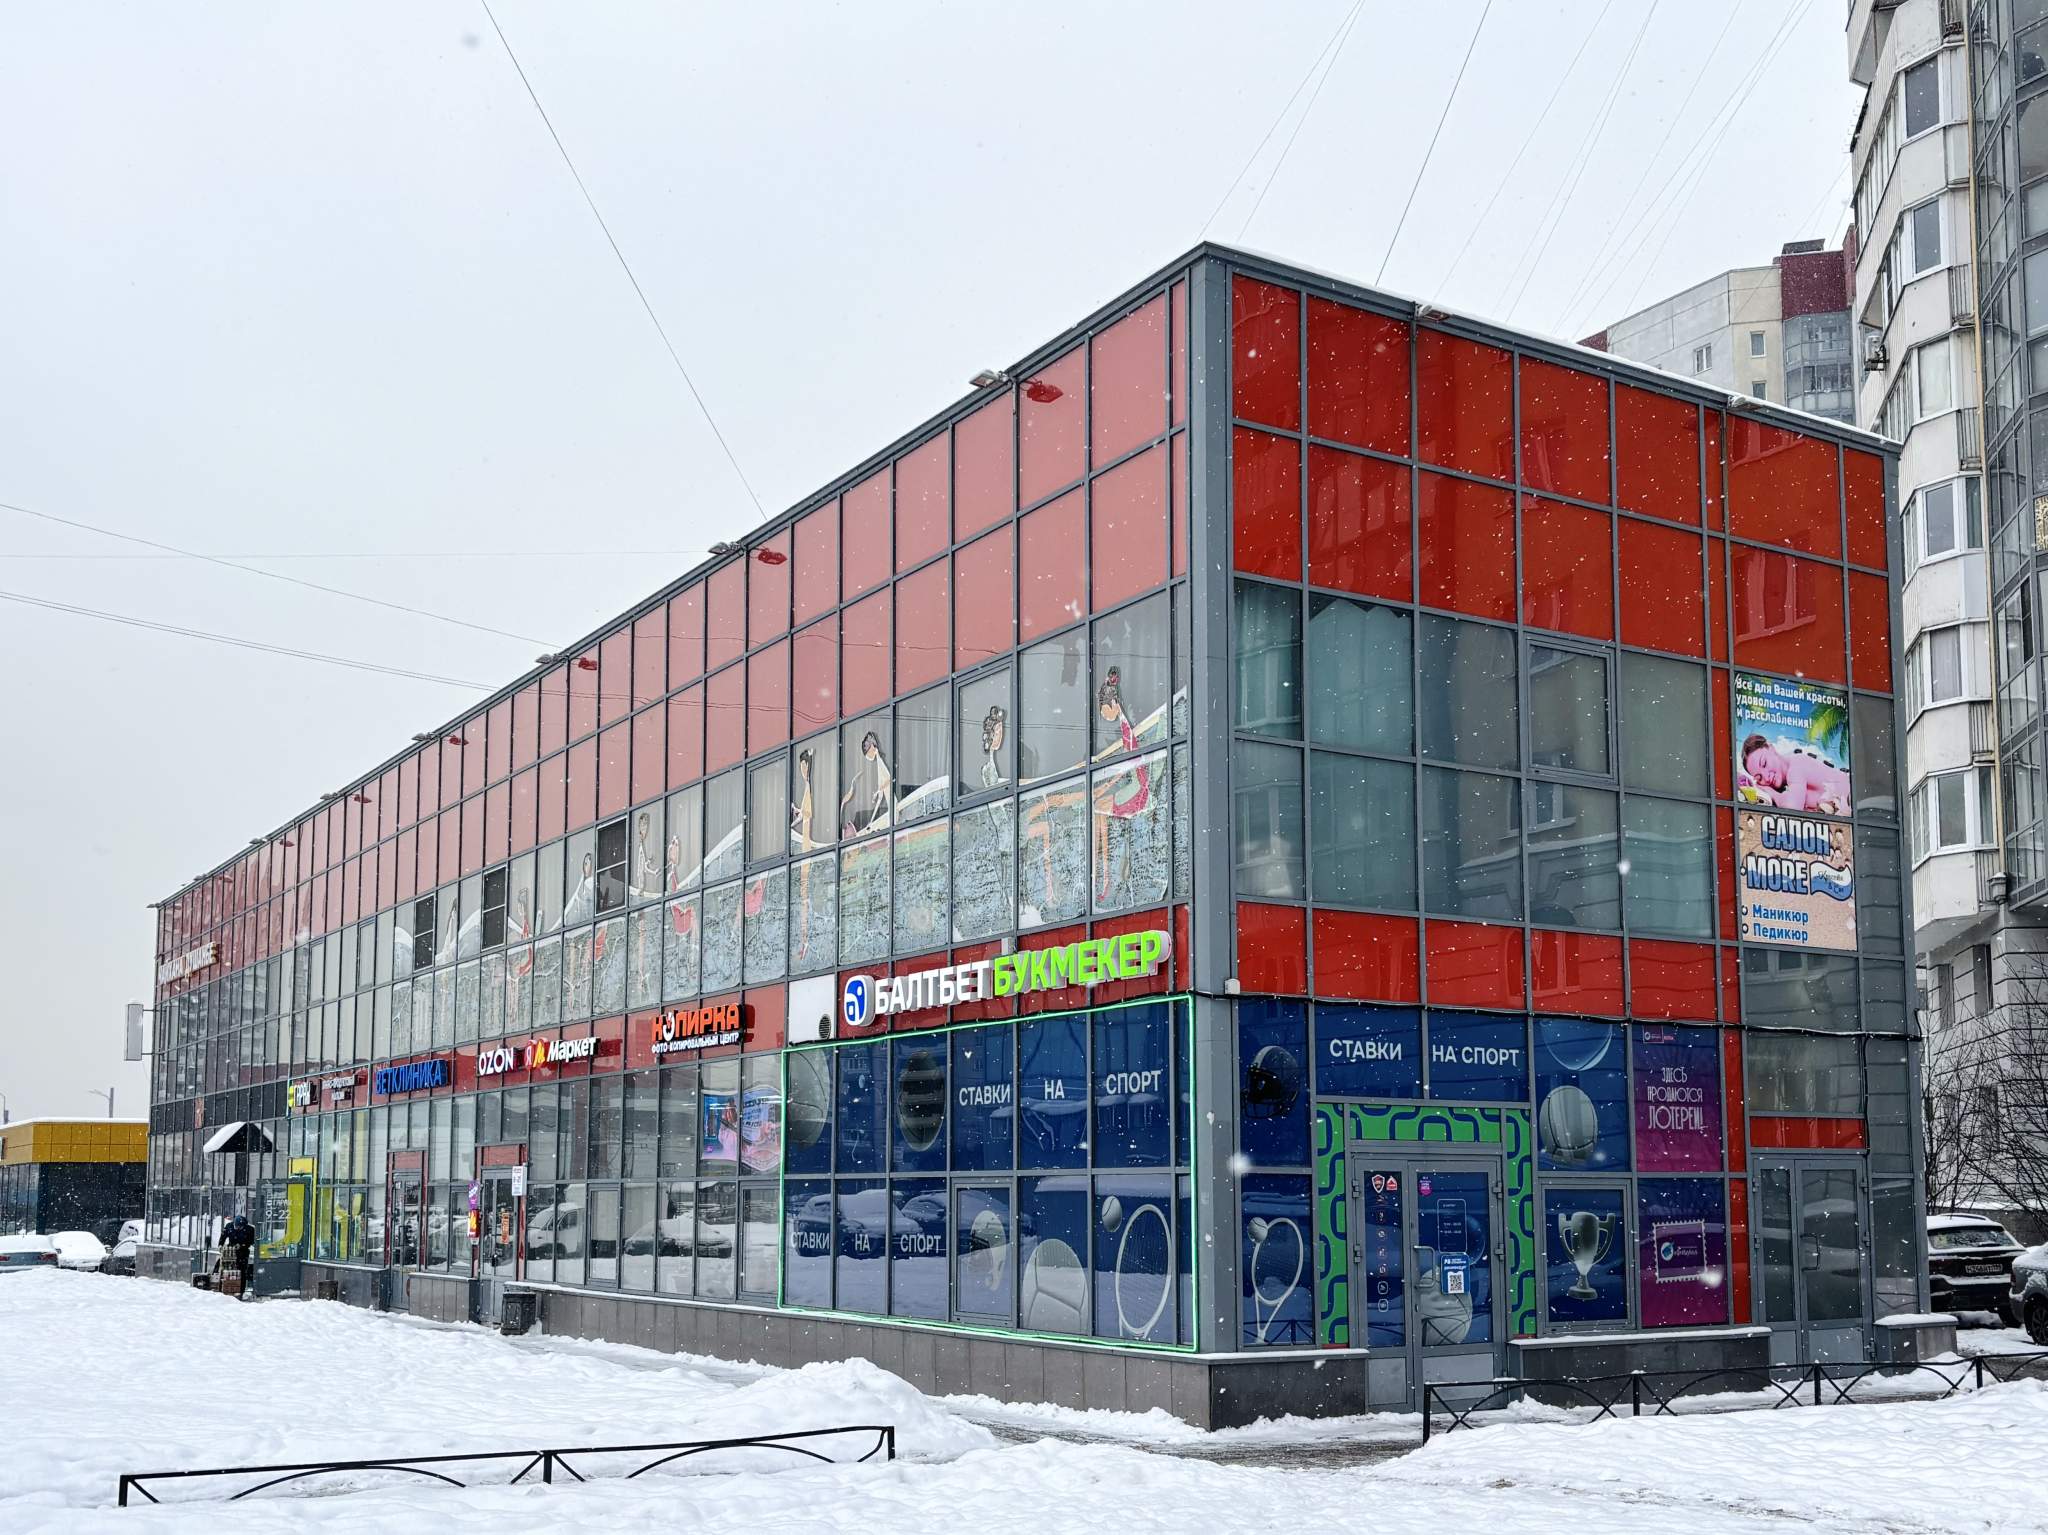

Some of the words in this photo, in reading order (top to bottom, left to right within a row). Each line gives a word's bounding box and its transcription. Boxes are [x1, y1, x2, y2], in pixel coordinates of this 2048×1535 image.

[1735, 693, 1800, 713] удовольствия
[1736, 677, 1752, 691] Все
[1754, 683, 1772, 694] для
[1774, 683, 1804, 700] Вашей
[1806, 692, 1847, 709] красоты,
[1736, 707, 1743, 717] и
[1745, 709, 1813, 729] расслабления!
[1760, 814, 1831, 857] САЛОН
[1752, 903, 1809, 926] Маникюр
[1753, 922, 1809, 944] Педикюр
[993, 930, 1167, 996] БУКМЕКЕР
[546, 1036, 597, 1062] Маркет
[719, 1031, 740, 1046] ЦЕНТР
[478, 1046, 514, 1076] OZON
[1329, 1038, 1403, 1062] СТАВКИ
[1432, 1044, 1457, 1063] НА
[1461, 1045, 1520, 1067] СПОРТ
[375, 1060, 443, 1095] ВЕТКЛИНИКА
[1661, 1066, 1688, 1083] ЗДЕСЬ
[958, 1083, 1011, 1107] СТАВКИ
[1044, 1079, 1065, 1100] НА
[1105, 1069, 1162, 1095] СПОРТ
[1647, 1085, 1703, 1103] ПРОДАЮТСЯ
[790, 1231, 830, 1250] СТАВКИ
[854, 1233, 871, 1252] НА
[899, 1233, 942, 1254] СПОРТ
